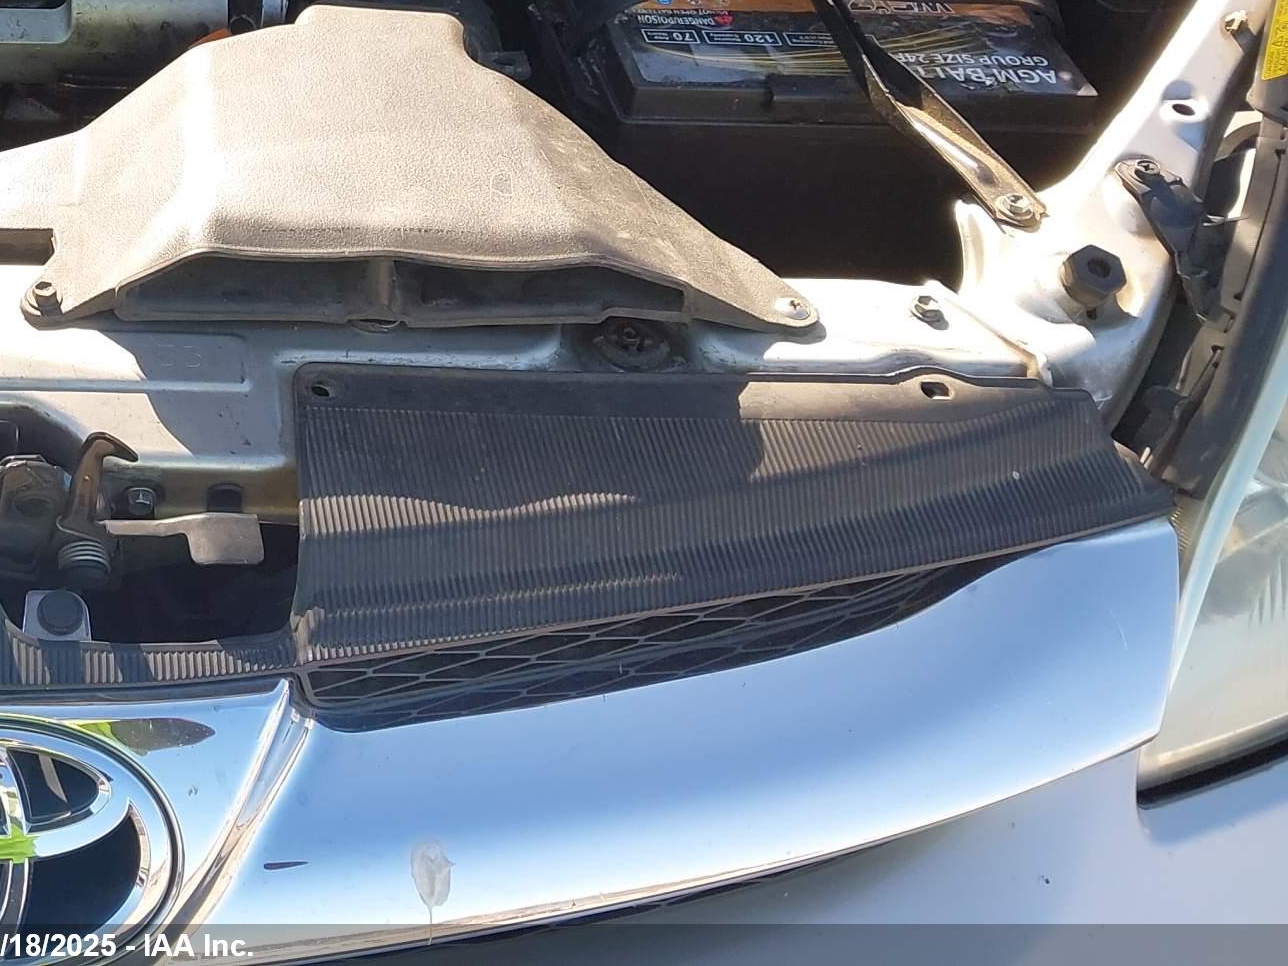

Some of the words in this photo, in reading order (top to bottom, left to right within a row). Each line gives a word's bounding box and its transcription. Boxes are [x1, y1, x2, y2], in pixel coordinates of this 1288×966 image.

[637, 14, 714, 26] DANGER/POISON
[673, 32, 693, 41] 70
[744, 34, 773, 42] 120
[932, 53, 976, 64] SIZE
[980, 54, 1048, 66] GROUP
[993, 68, 1057, 84] AGM
